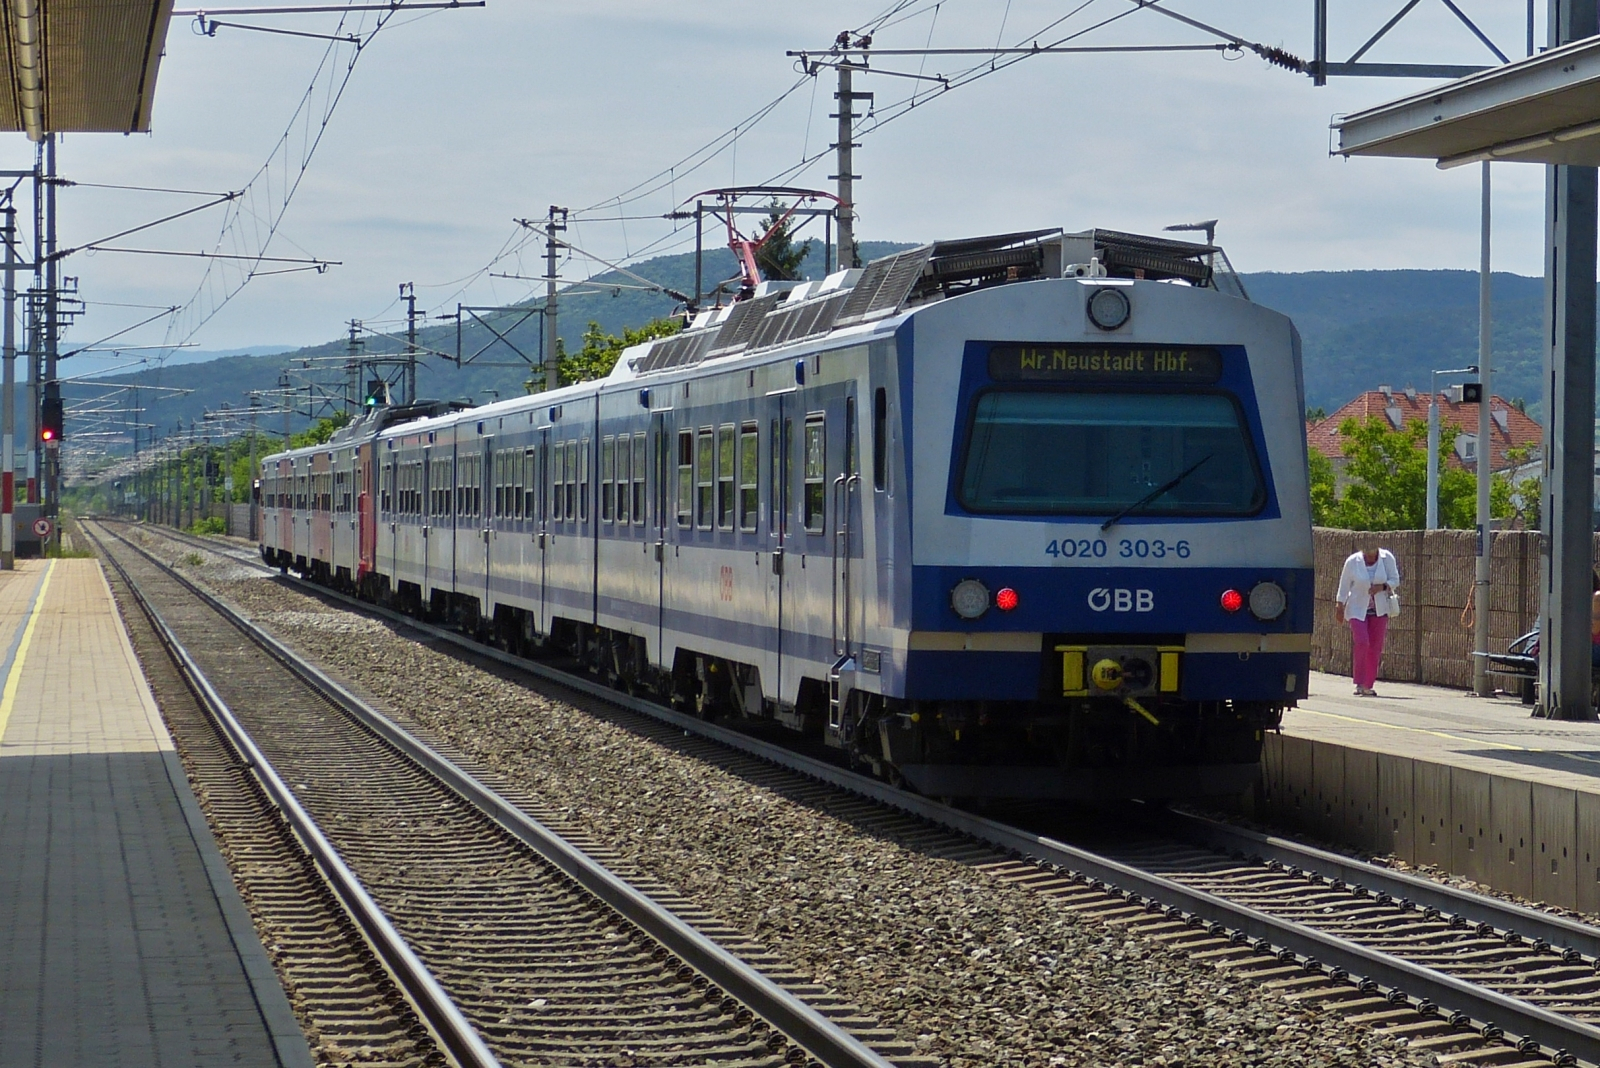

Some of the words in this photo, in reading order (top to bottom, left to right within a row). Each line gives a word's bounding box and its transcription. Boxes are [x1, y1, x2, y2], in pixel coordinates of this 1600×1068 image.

[1154, 350, 1193, 372] Hbf.
[1045, 539, 1107, 558] 4020
[1119, 539, 1191, 558] 303-6
[1087, 587, 1155, 612] ÖBB
